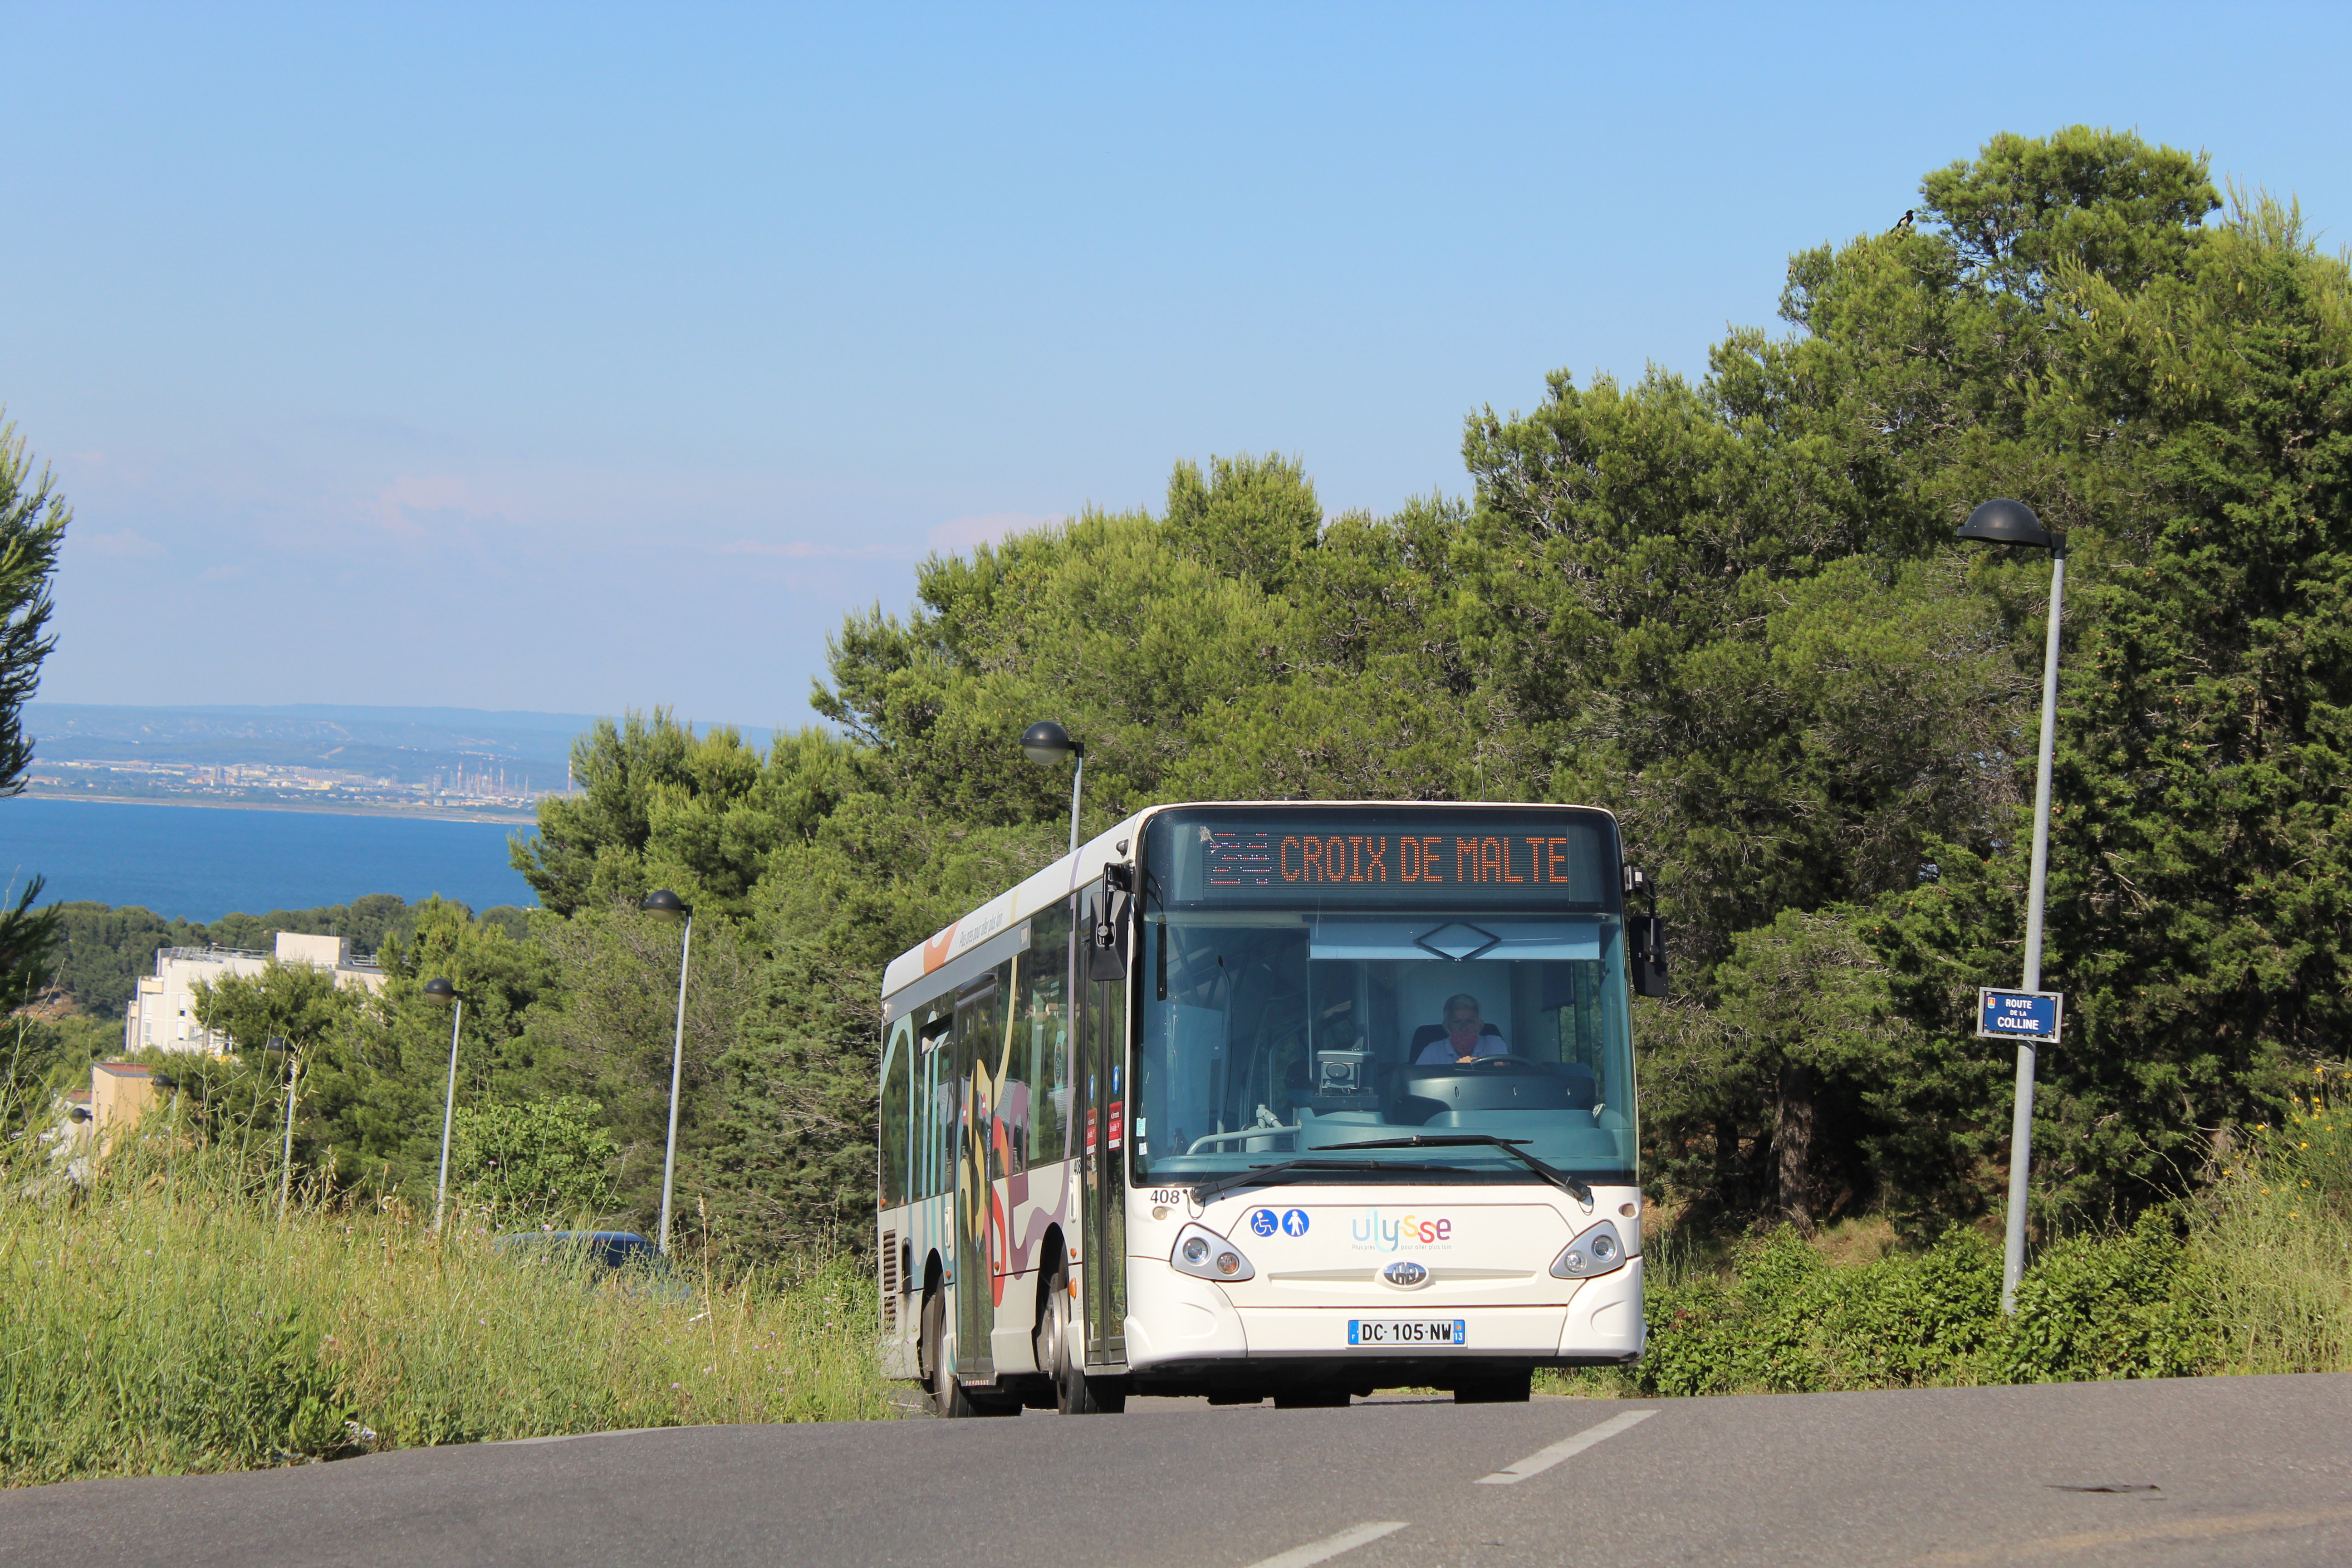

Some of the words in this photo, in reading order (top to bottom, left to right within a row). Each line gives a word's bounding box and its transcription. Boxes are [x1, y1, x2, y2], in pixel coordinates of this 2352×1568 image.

[1281, 836, 1386, 882] CROIX
[1401, 837, 1442, 882] DE
[1456, 837, 1568, 882] MALTE
[2005, 999, 2033, 1009] ROUTE
[1997, 1017, 2039, 1030] COLLINE
[1150, 1190, 1180, 1204] 408
[1352, 1207, 1451, 1253] ulysse
[1455, 1332, 1463, 1341] 13
